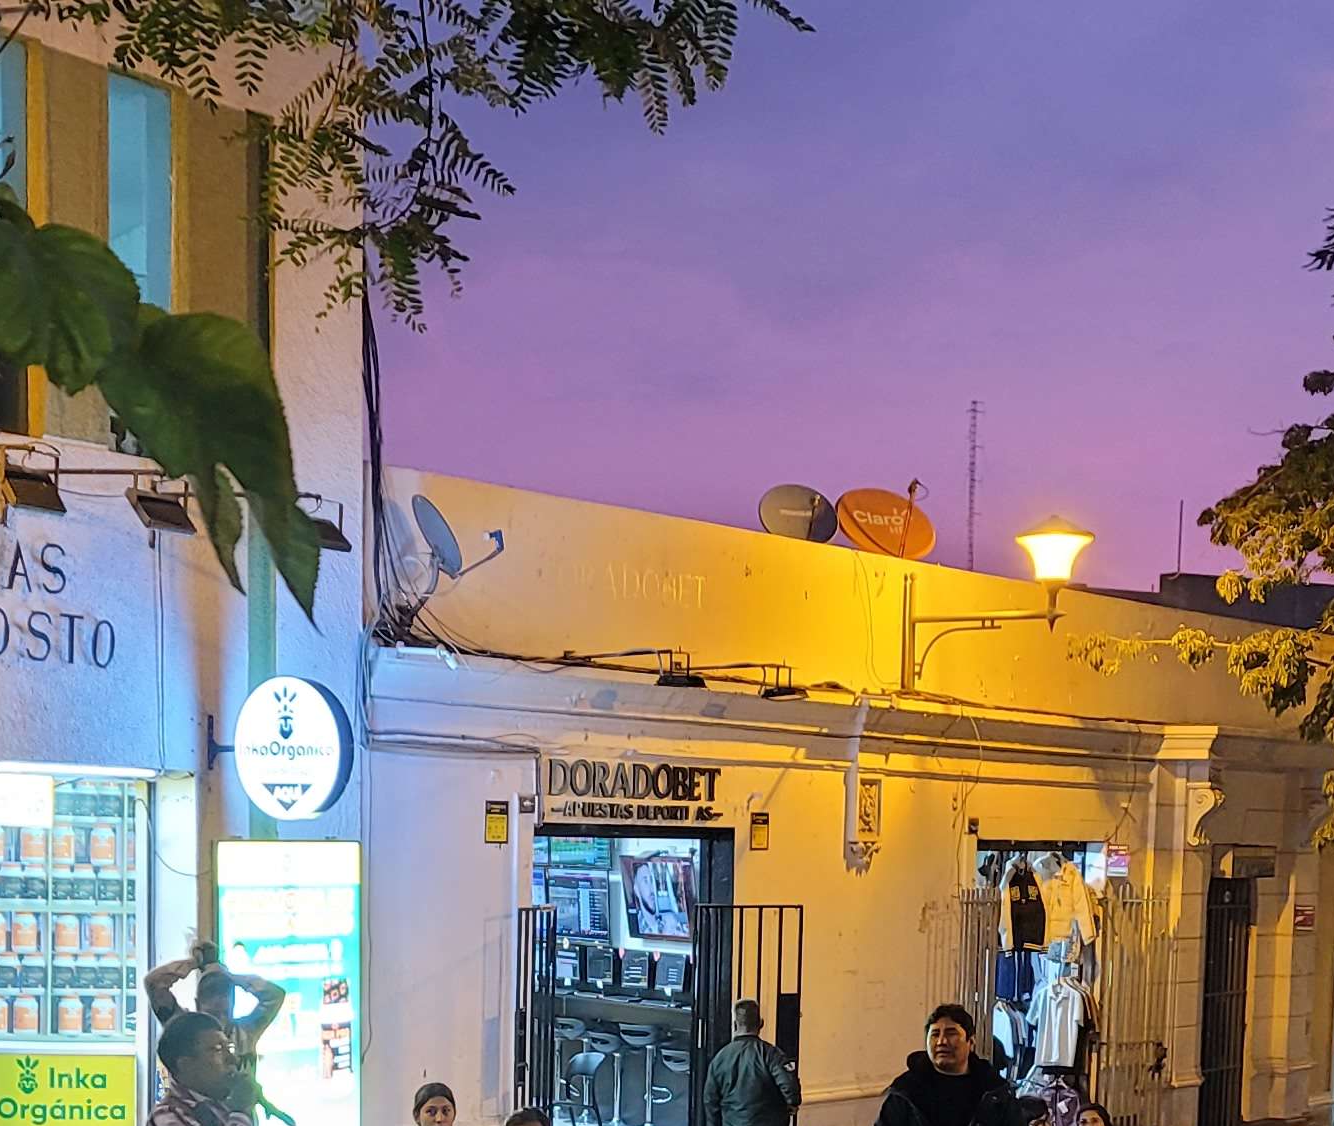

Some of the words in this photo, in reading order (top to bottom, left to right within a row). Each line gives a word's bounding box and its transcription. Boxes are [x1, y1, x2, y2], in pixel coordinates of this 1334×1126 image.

[852, 509, 905, 526] Claro
[548, 758, 722, 802] DORADOBET
[563, 800, 634, 820] APUESTAS
[636, 804, 714, 821] DEPORTIAS
[48, 1066, 107, 1089] Inka
